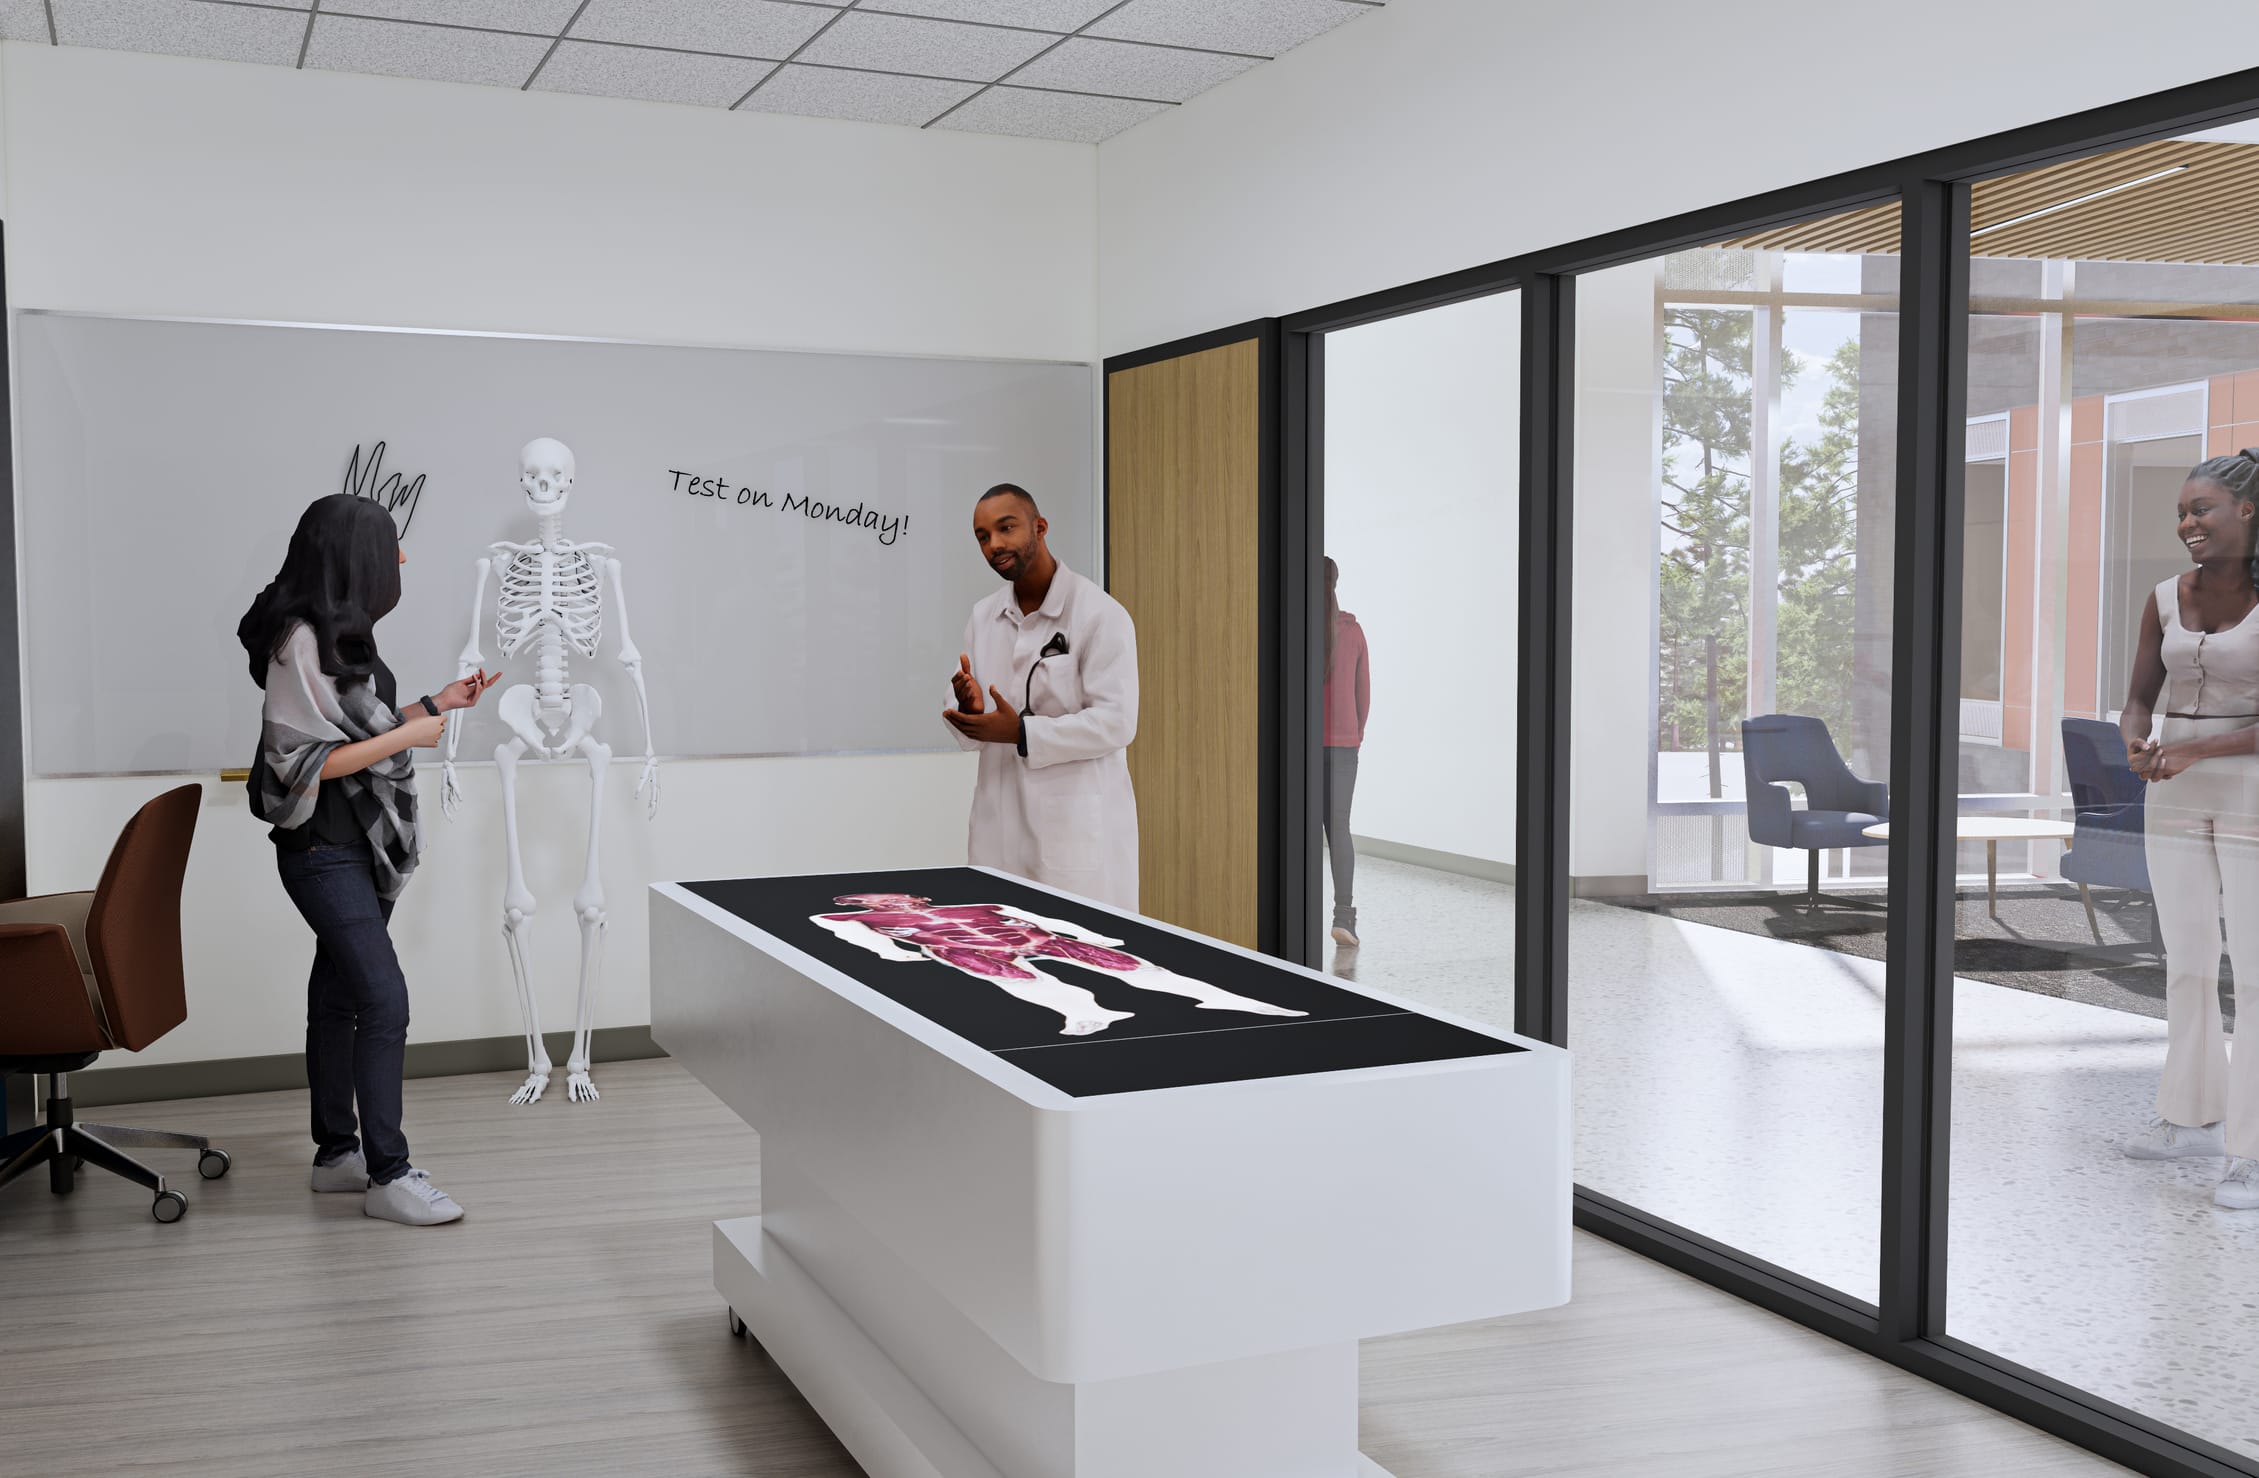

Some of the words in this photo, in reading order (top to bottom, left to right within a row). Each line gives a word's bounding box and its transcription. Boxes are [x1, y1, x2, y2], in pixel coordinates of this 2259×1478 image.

[668, 469, 730, 500] Test
[737, 487, 773, 508] on
[781, 493, 909, 545] Monday!
